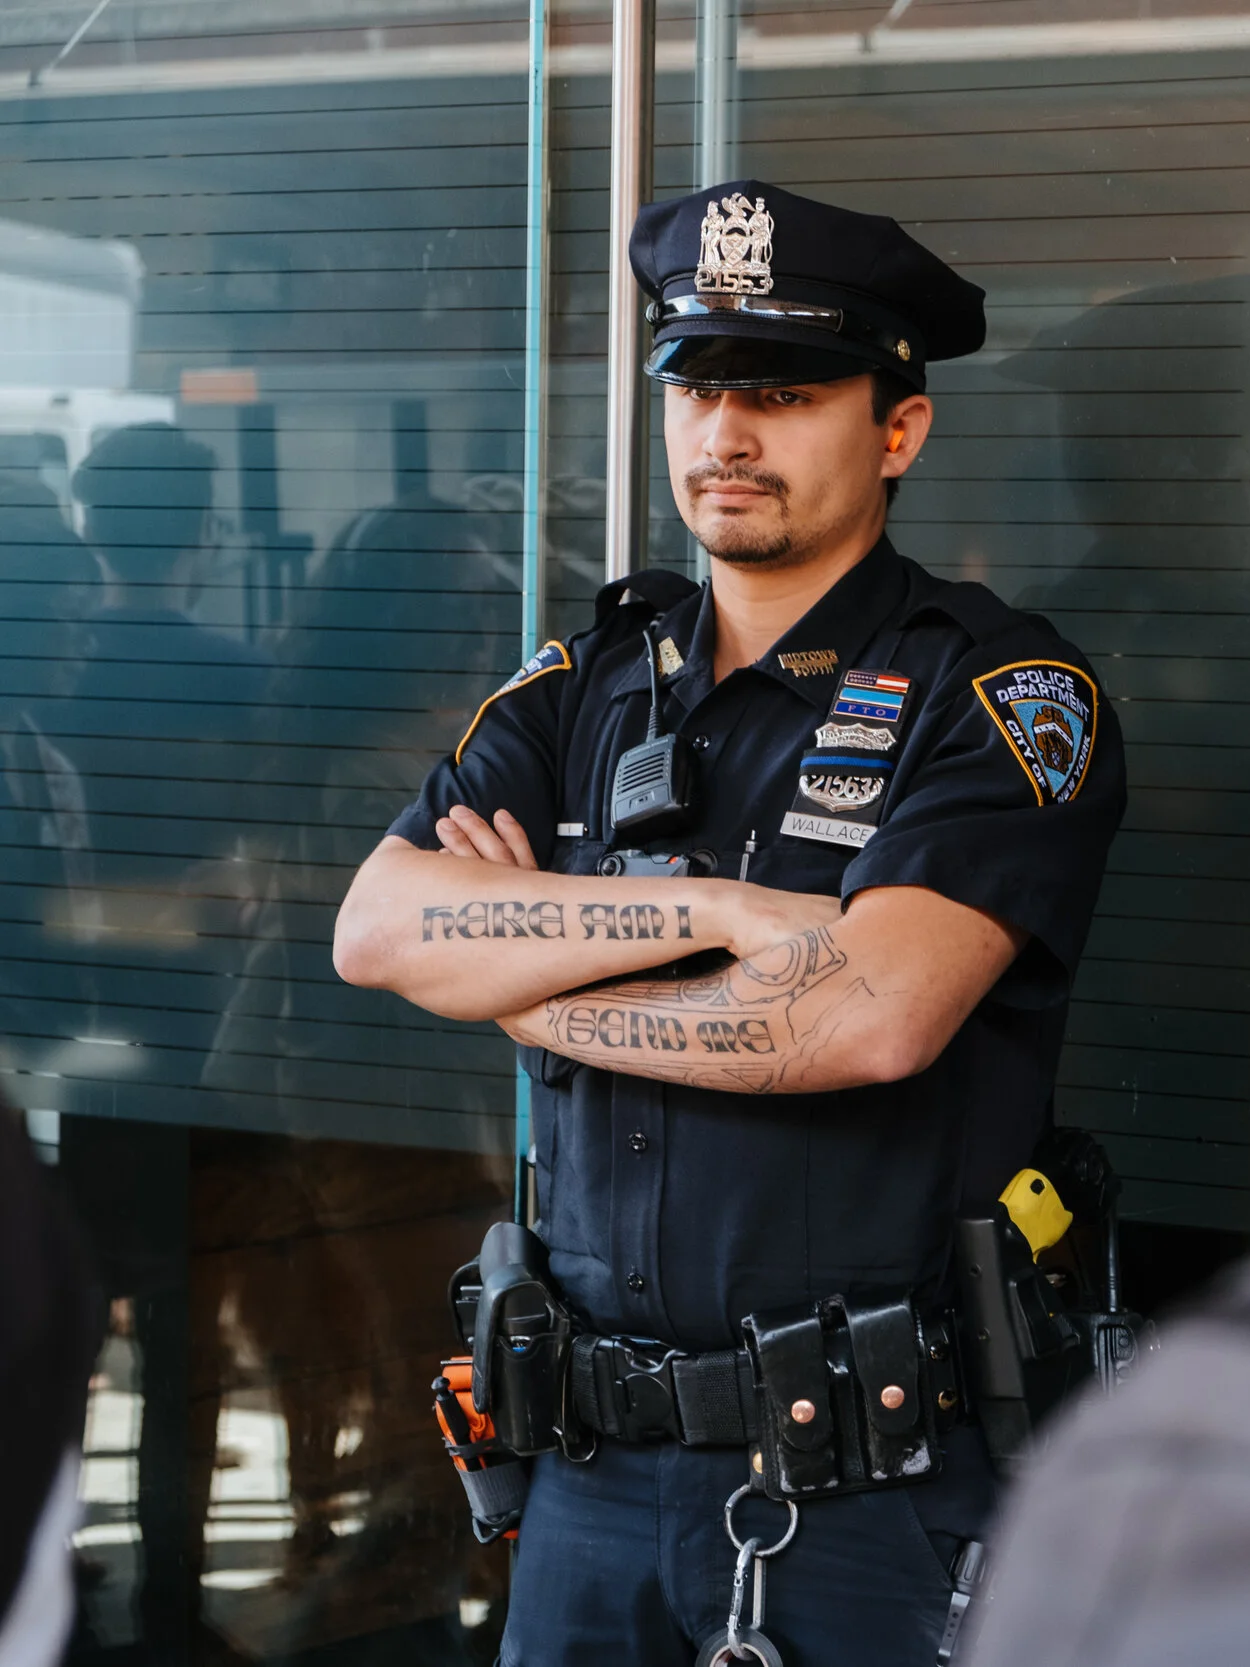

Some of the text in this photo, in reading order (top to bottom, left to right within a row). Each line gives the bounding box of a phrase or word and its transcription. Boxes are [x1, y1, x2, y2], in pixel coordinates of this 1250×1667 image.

[696, 269, 770, 295] 21563
[1013, 669, 1075, 693] POLICE
[995, 683, 1090, 722] DEPARTMENT
[1006, 719, 1048, 788] CITY OF
[1073, 735, 1091, 778] YORK
[808, 774, 873, 800] 21563
[791, 817, 870, 842] WALLACE
[577, 902, 665, 941] AM
[673, 905, 694, 939] I
[566, 1007, 777, 1054] SEND ME
